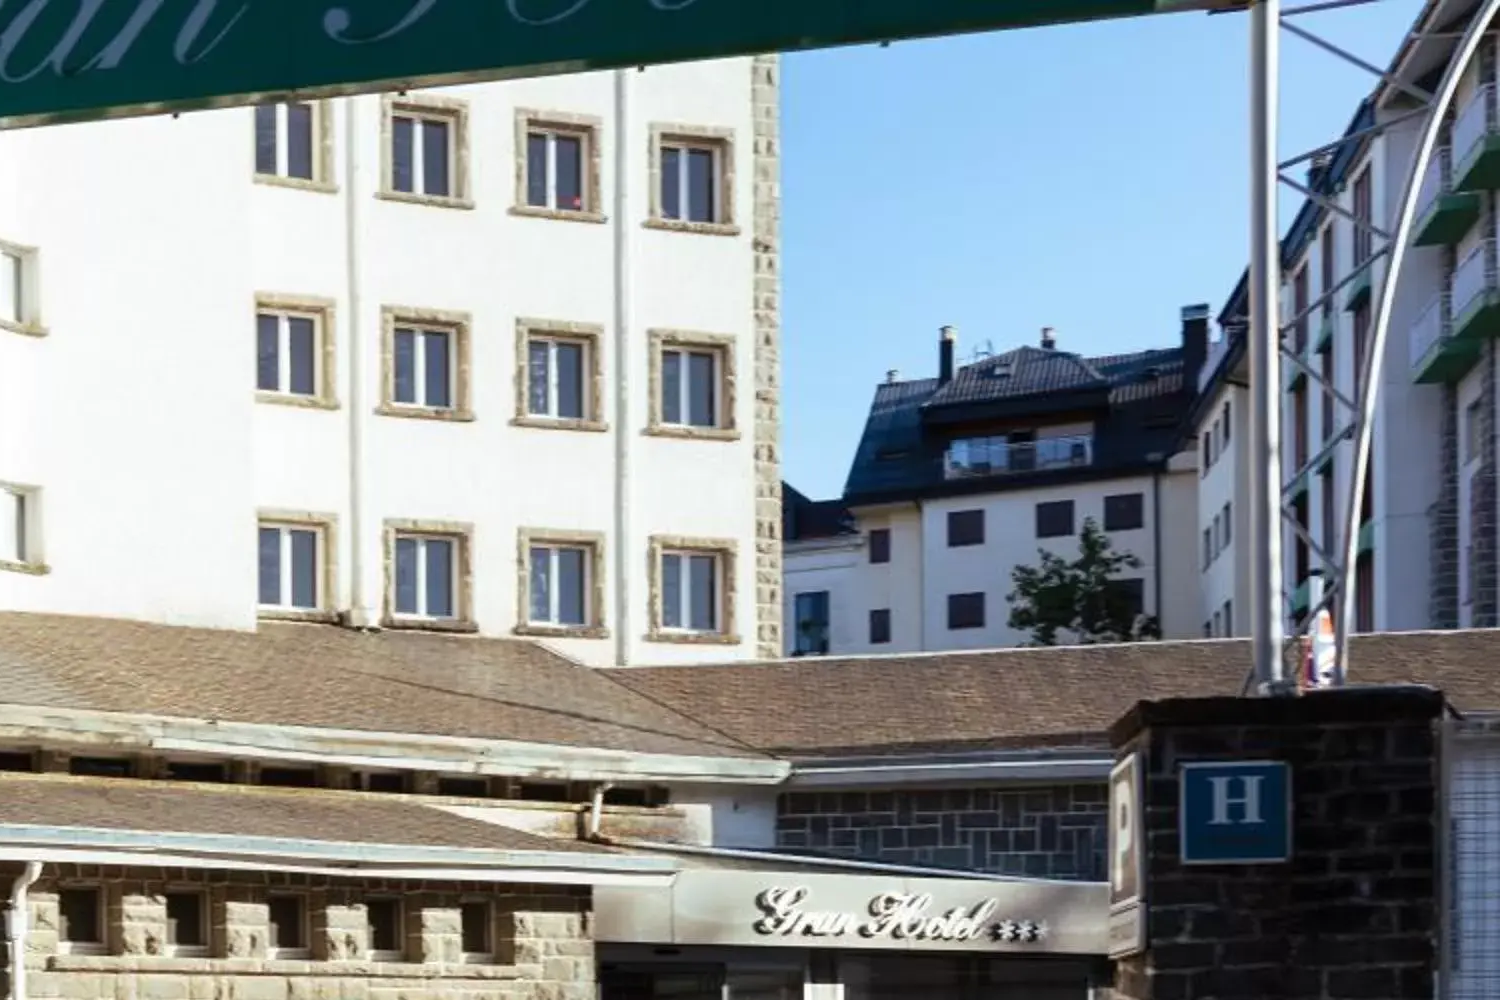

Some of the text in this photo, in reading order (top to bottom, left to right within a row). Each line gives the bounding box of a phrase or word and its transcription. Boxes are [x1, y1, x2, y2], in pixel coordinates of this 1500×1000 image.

[1206, 775, 1266, 825] H
[756, 885, 998, 941] Gran Hotel
